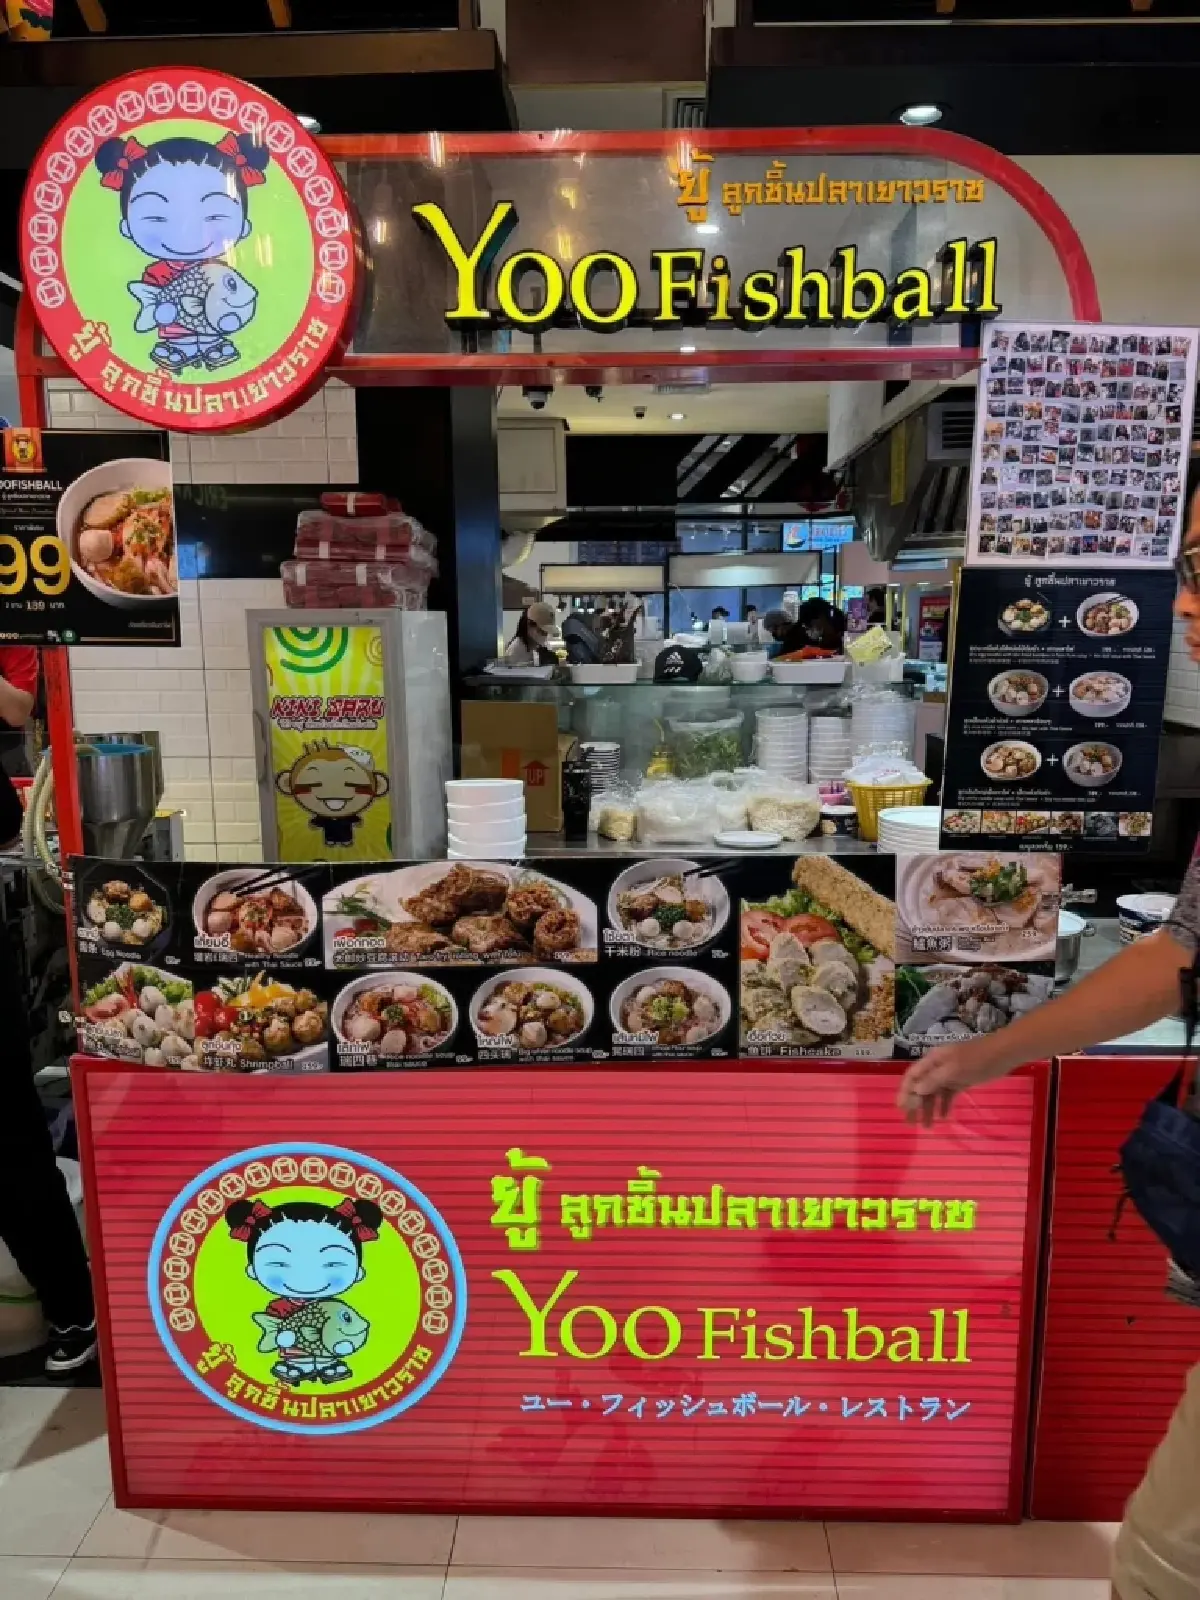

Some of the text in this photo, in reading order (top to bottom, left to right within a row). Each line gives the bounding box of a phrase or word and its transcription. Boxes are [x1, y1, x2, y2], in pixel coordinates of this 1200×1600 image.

[413, 202, 1000, 324] Yoo Fishball
[526, 768, 543, 784] UP
[561, 1166, 976, 1240] ลูกชิ้นปลาเยาวราช
[491, 1269, 972, 1363] Yoo Fishball
[520, 1391, 971, 1422] ユー・フィッシュボール・レストラン
